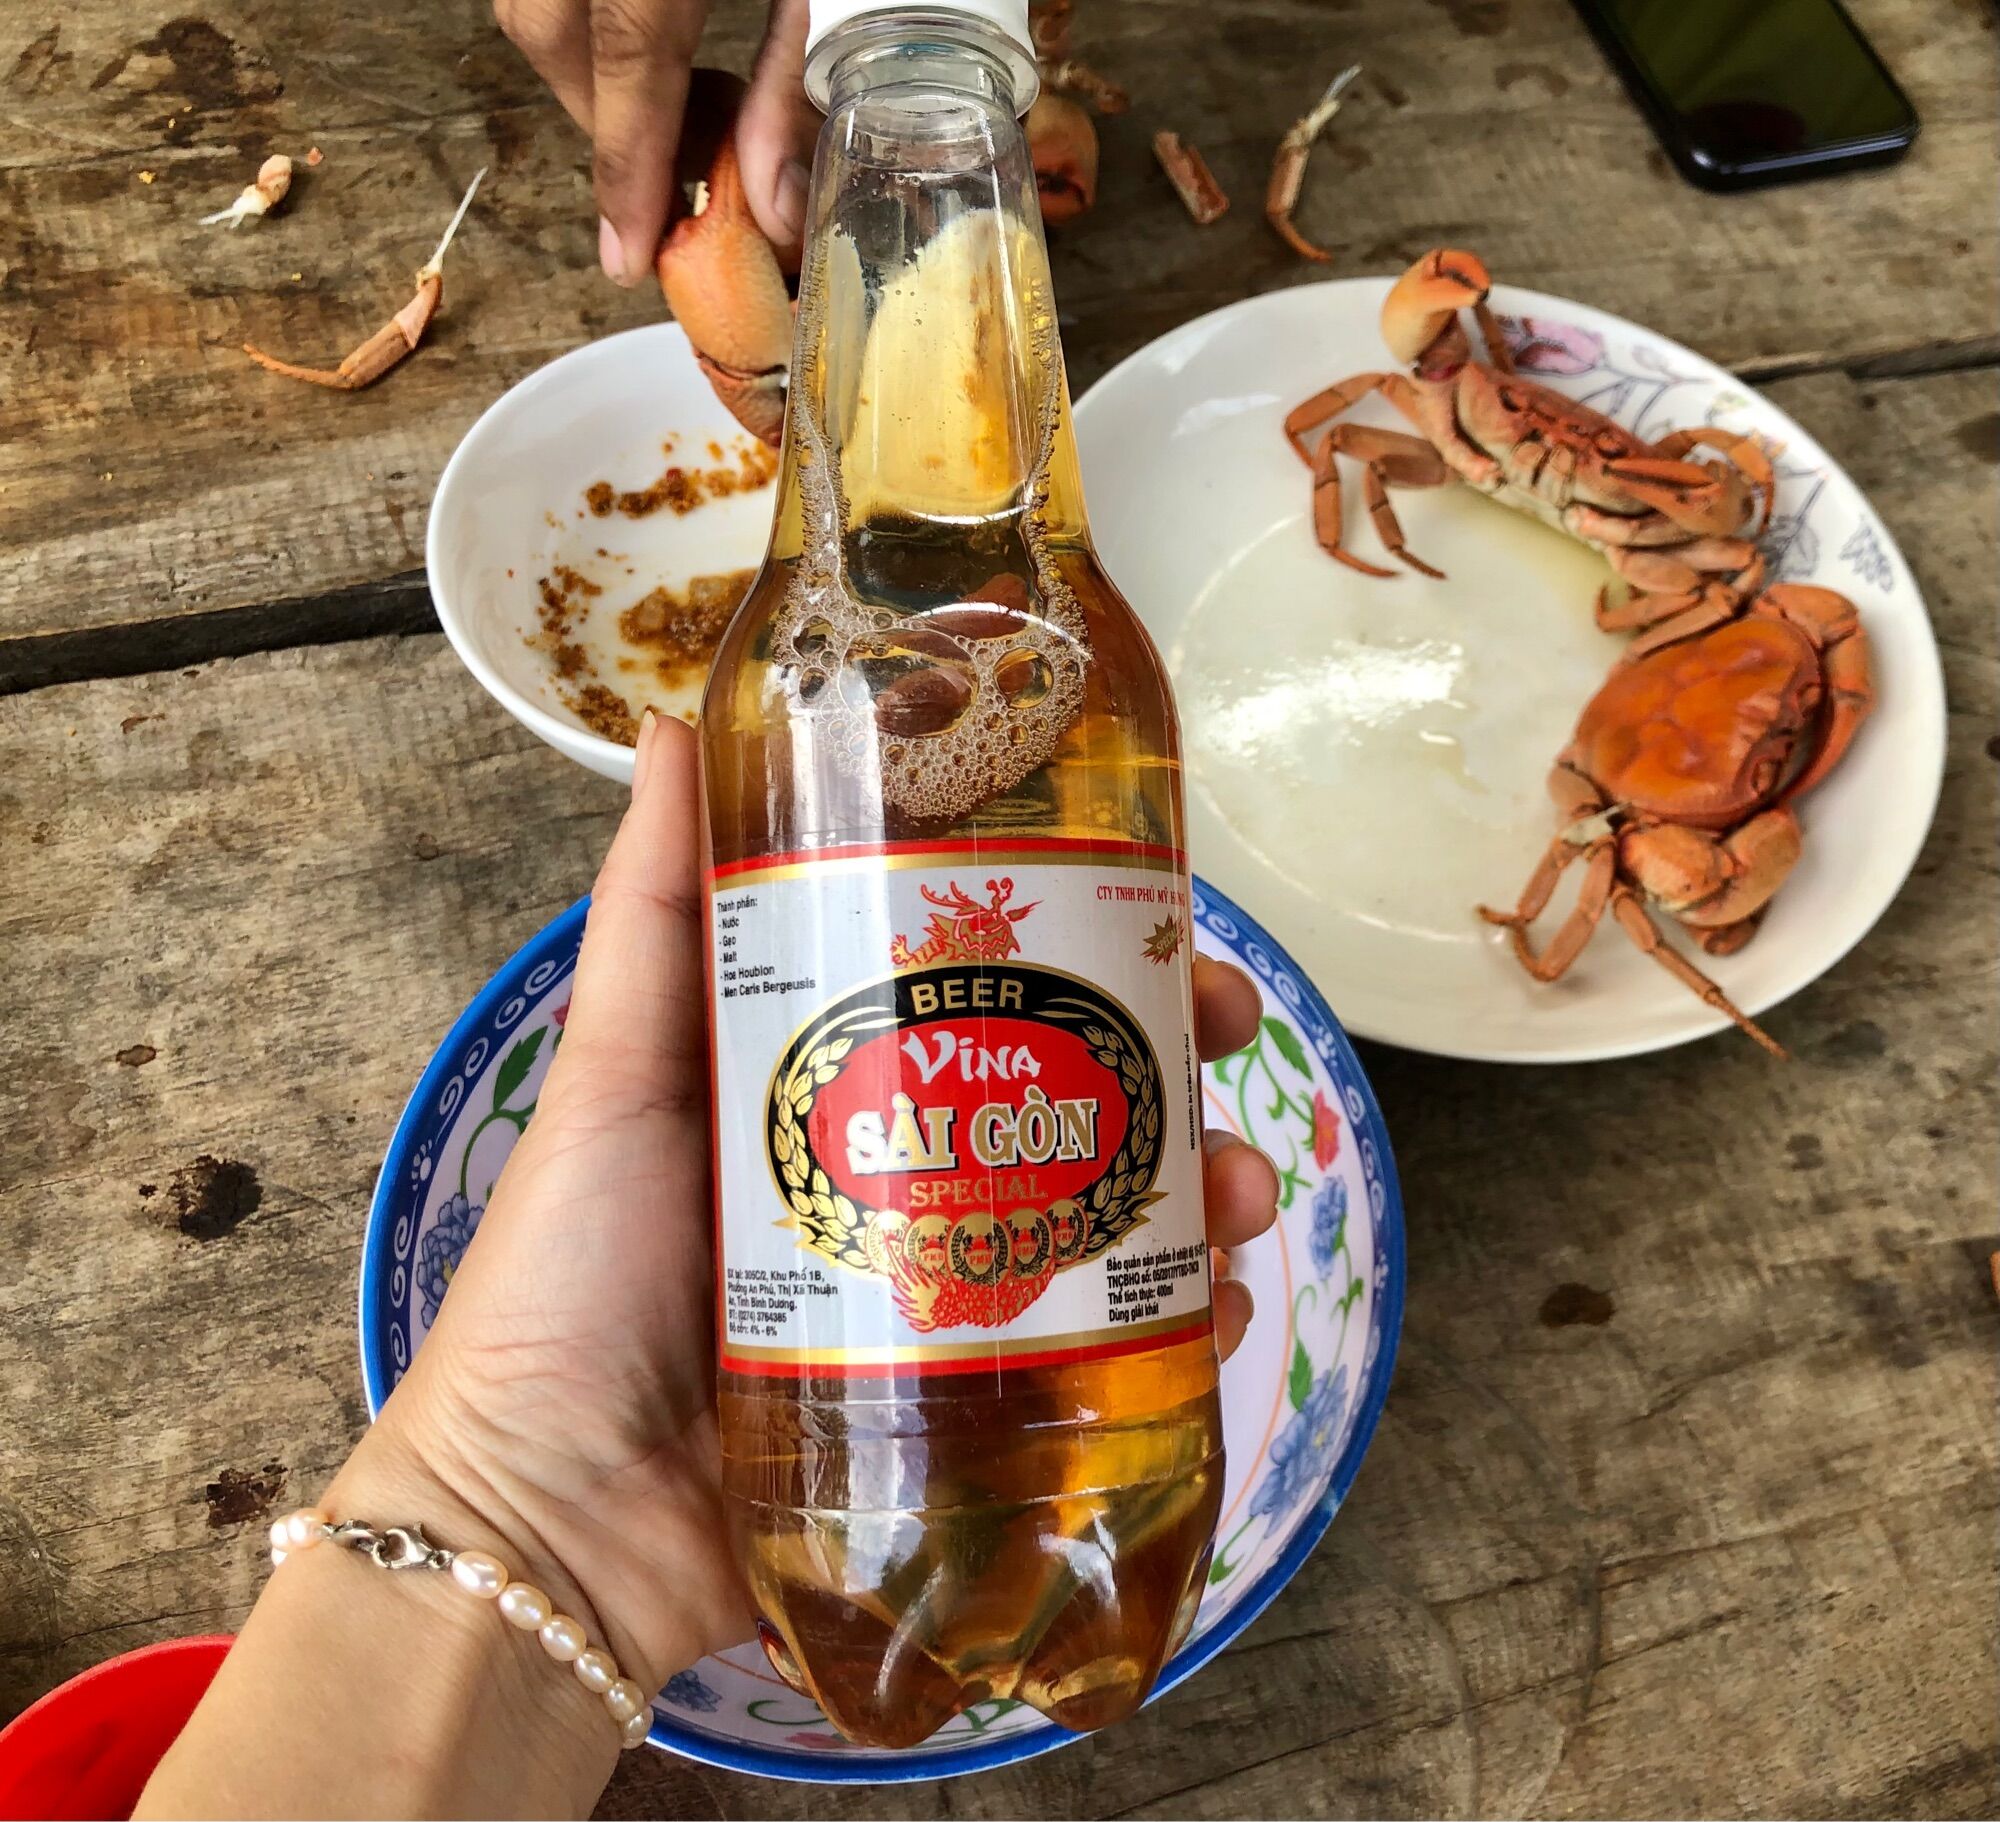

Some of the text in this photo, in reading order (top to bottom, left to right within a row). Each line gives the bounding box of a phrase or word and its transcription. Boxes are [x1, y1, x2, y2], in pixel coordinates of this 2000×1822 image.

[1096, 885, 1113, 900] CTY
[1115, 886, 1135, 901] TNHH
[1137, 885, 1154, 902] PHÚ
[738, 965, 775, 979] Houblon
[911, 978, 1024, 1015] BEER
[845, 1084, 1098, 1175] SÀI GÒN
[910, 1174, 1049, 1207] SPECIAL
[1107, 1257, 1122, 1272] Bảo
[1123, 1254, 1141, 1272] quản
[1142, 1252, 1154, 1267] sản
[770, 1270, 787, 1281] Khu
[789, 1267, 807, 1280] Phố
[809, 1270, 825, 1282] 1B,
[749, 1284, 758, 1294] An
[778, 1284, 791, 1296] Thị
[807, 1284, 838, 1298] Thuận
[1124, 1289, 1138, 1303] tích
[1109, 1307, 1130, 1323] Dùng
